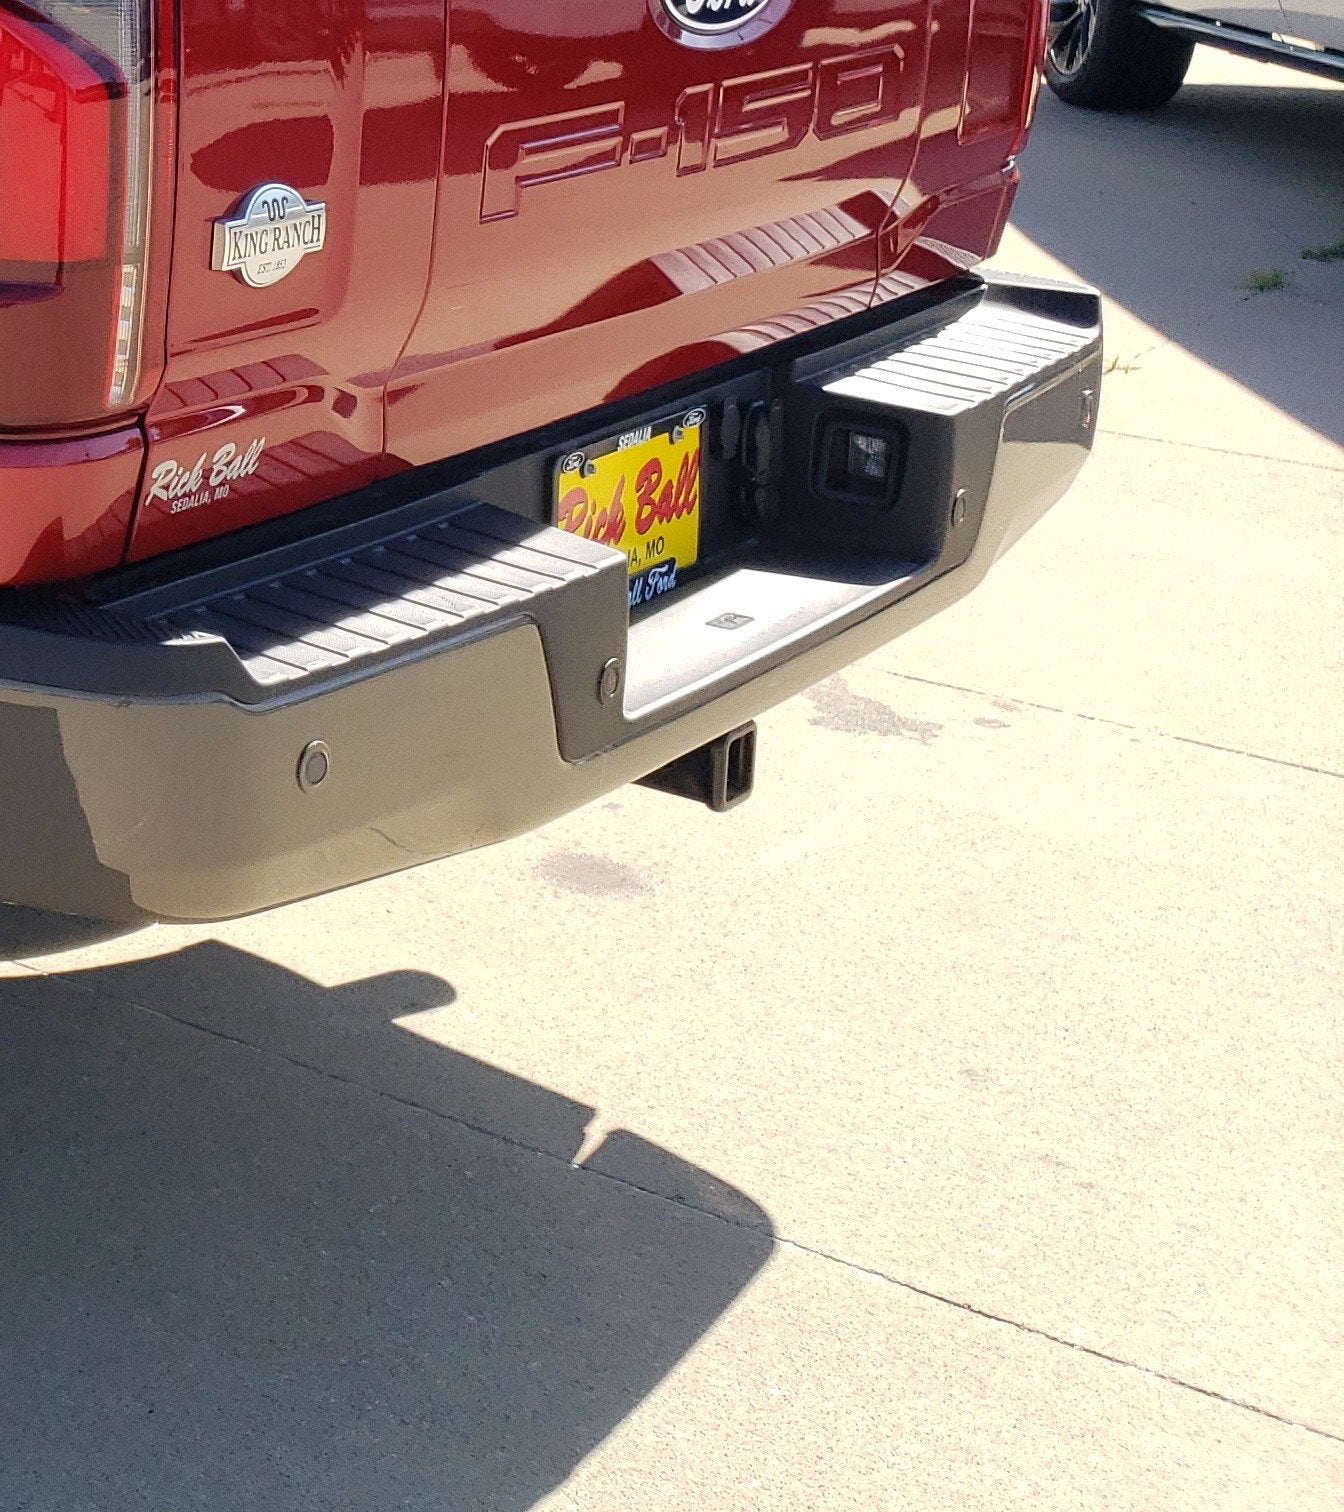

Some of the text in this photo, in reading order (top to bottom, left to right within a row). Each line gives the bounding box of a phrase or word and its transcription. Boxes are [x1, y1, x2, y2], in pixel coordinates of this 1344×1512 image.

[479, 43, 907, 224] F-150
[232, 214, 322, 261] KING RANCH
[617, 425, 652, 452] SEDALIA
[145, 436, 266, 507] Rick Ball
[213, 484, 230, 501] MO
[558, 447, 700, 545] Rick Ball
[645, 535, 665, 560] MO
[645, 564, 677, 601] Ford
